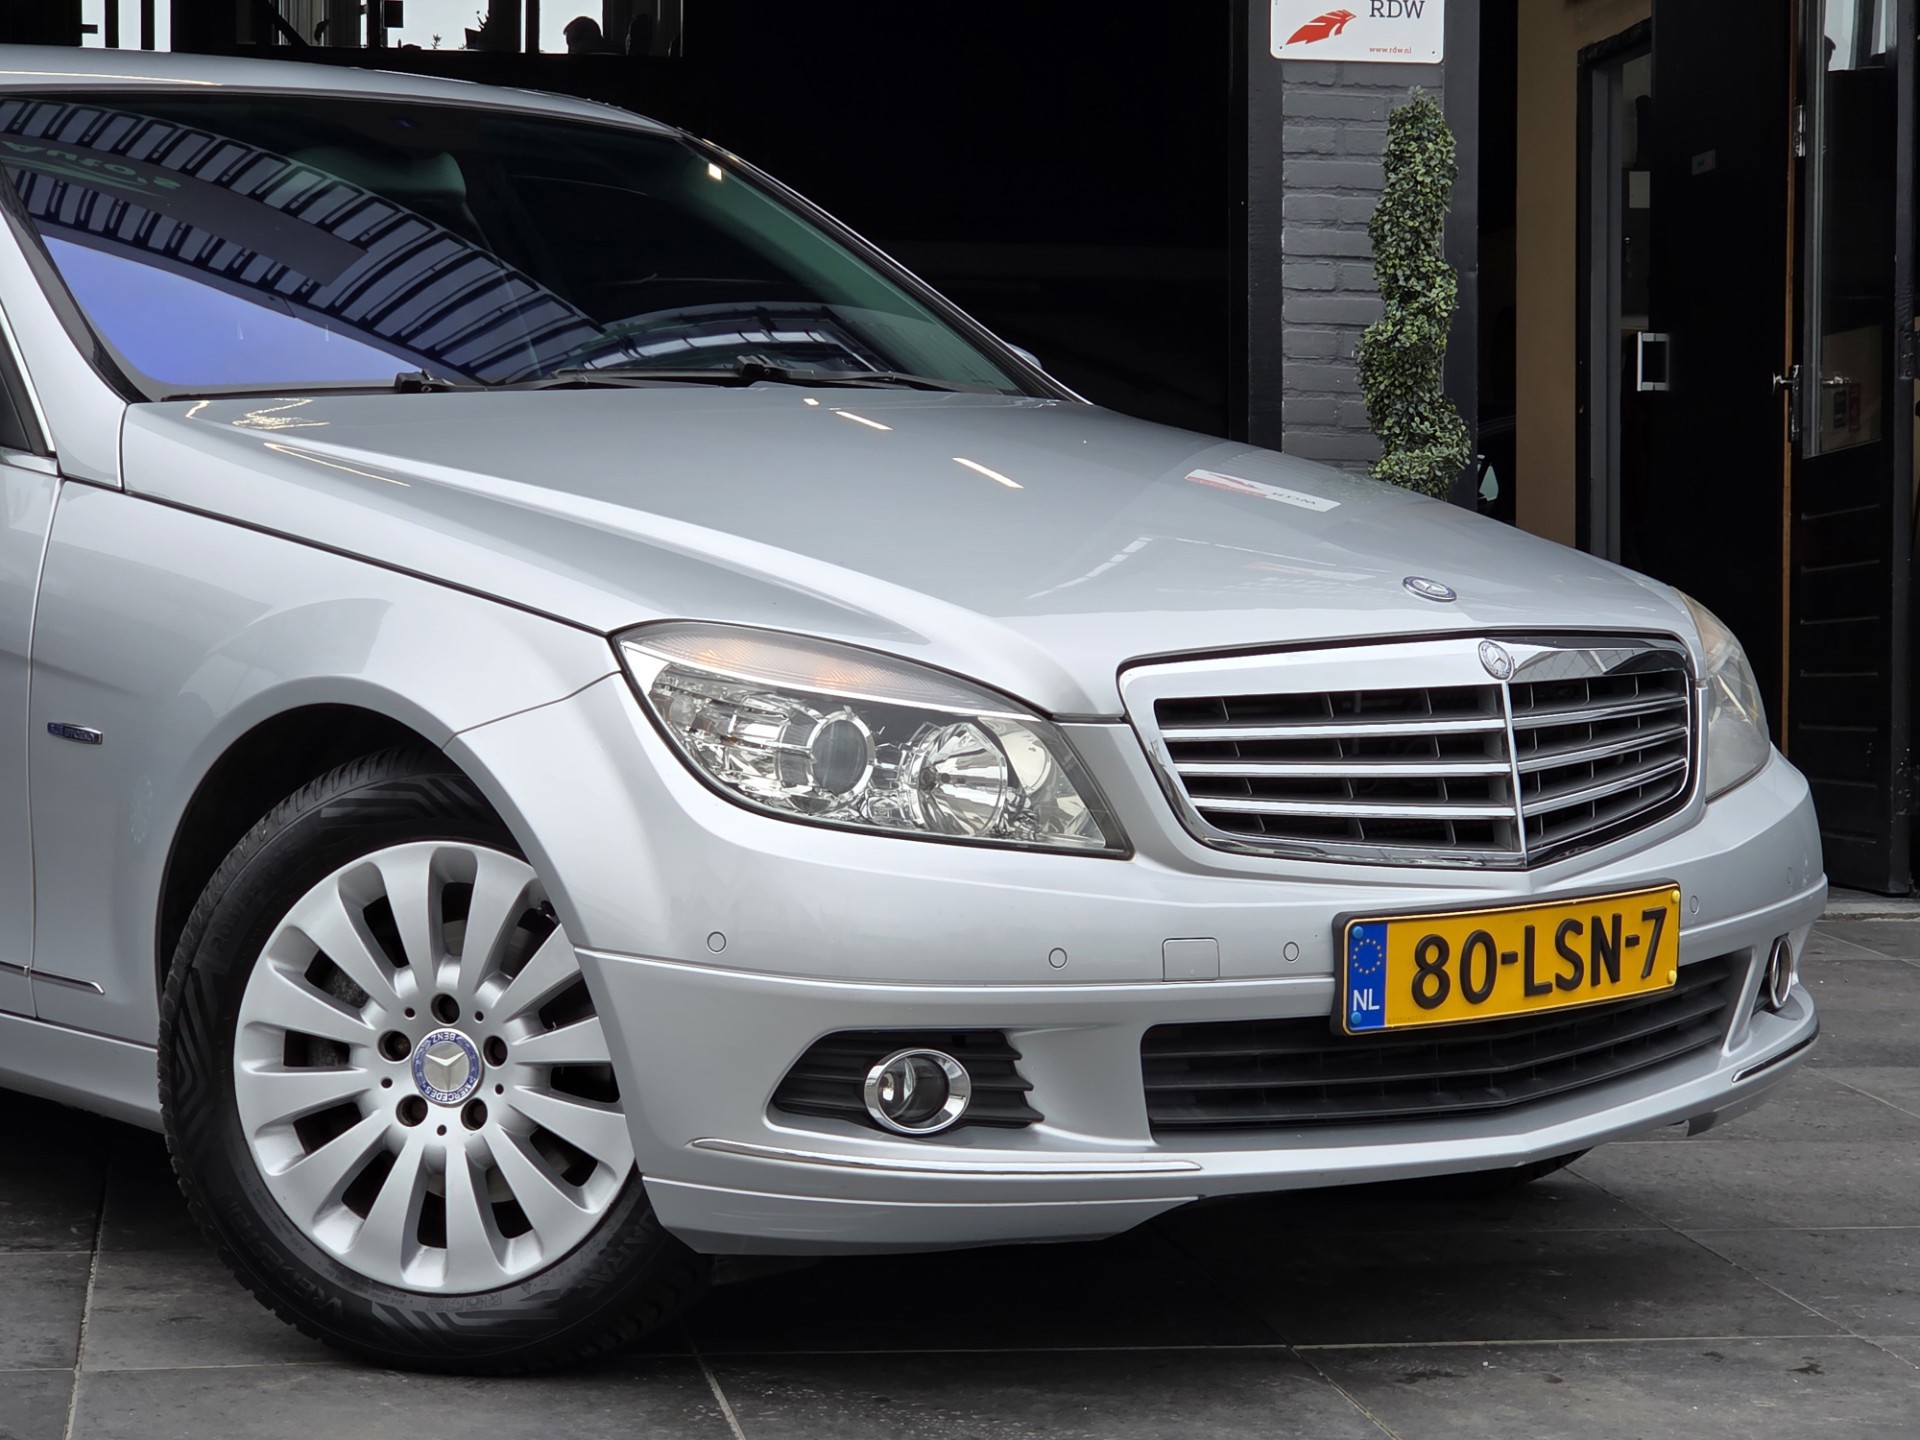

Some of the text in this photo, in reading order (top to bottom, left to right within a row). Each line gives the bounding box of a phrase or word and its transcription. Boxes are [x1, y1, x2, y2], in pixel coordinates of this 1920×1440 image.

[1369, 0, 1425, 19] RDW
[1369, 46, 1412, 54] www.rdw.nl
[1411, 906, 1667, 1010] 80-LSN-7
[1352, 988, 1380, 1012] NL
[431, 1032, 456, 1043] BENZ
[425, 1082, 472, 1101] MERCEDES
